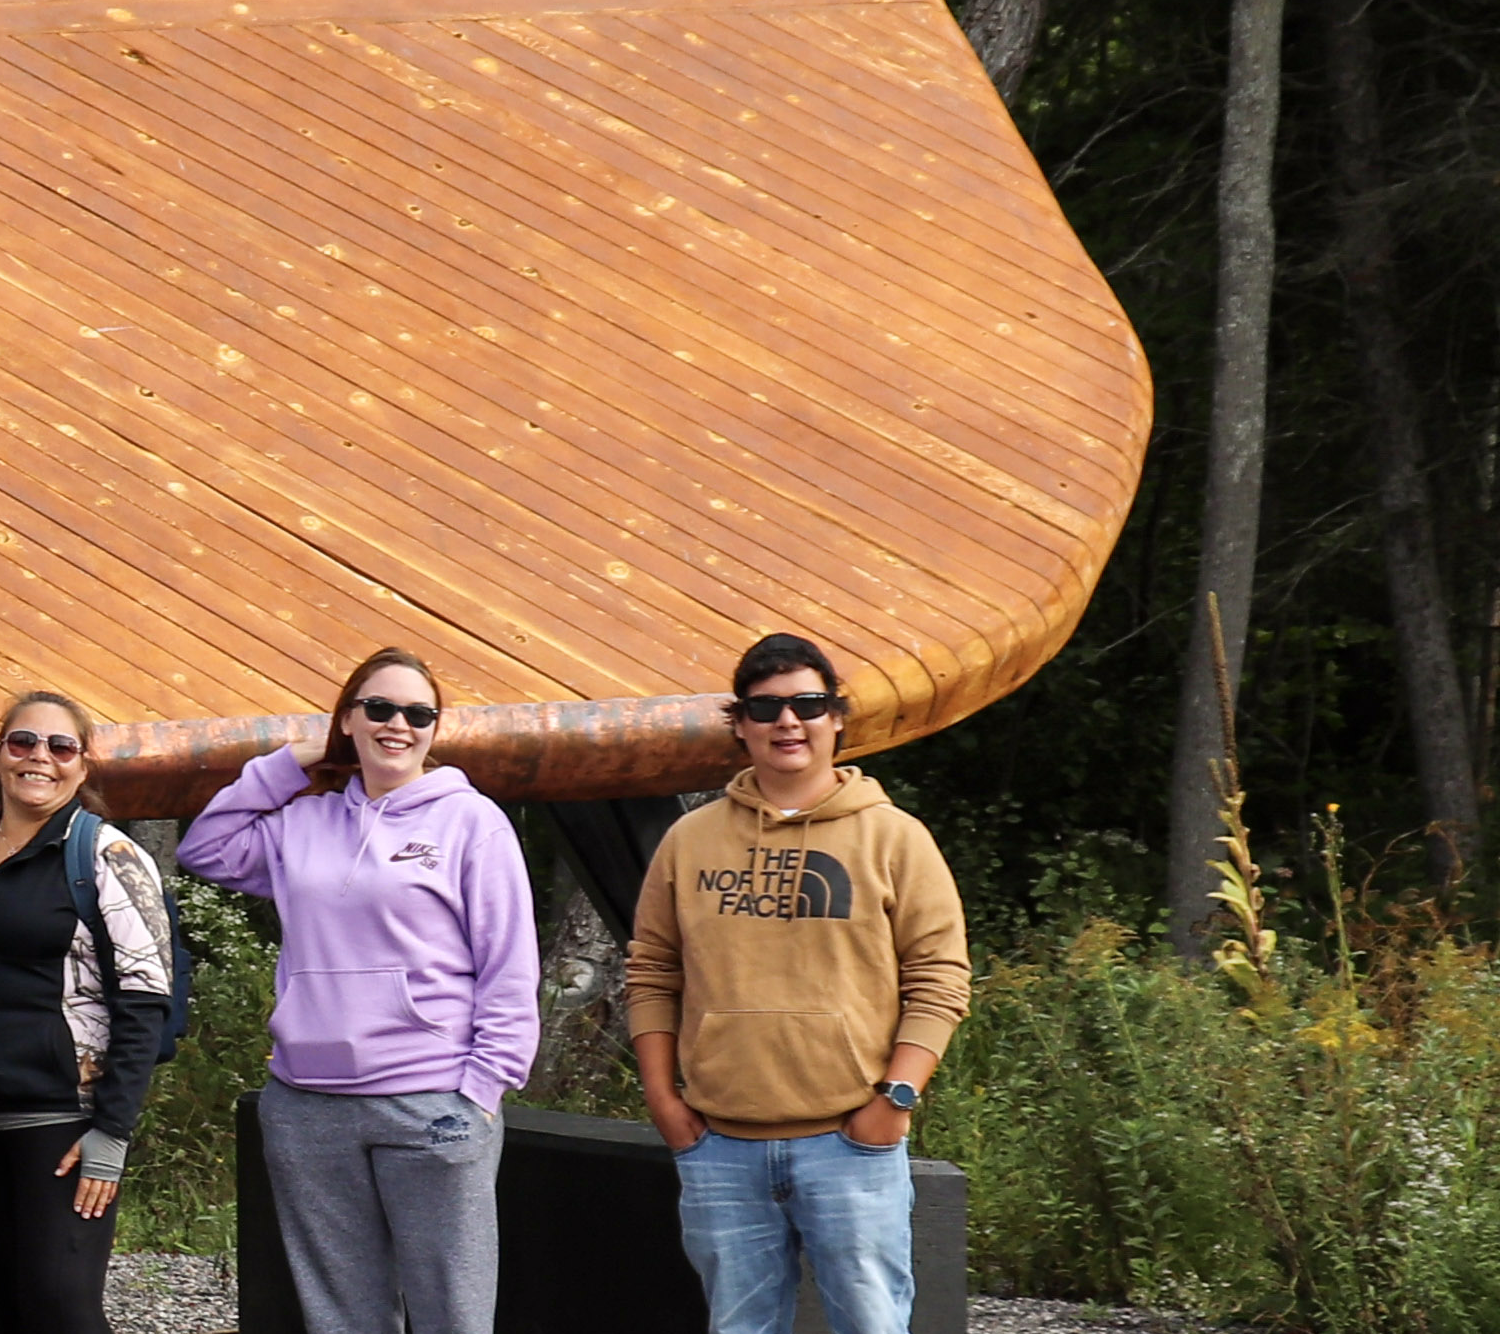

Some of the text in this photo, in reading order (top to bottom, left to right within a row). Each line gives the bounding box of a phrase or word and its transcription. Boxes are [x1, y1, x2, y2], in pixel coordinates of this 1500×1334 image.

[401, 842, 439, 855] NIKE
[747, 847, 802, 870] THE
[419, 857, 439, 870] SB
[697, 869, 797, 893] NORTH
[718, 893, 794, 919] FACE
